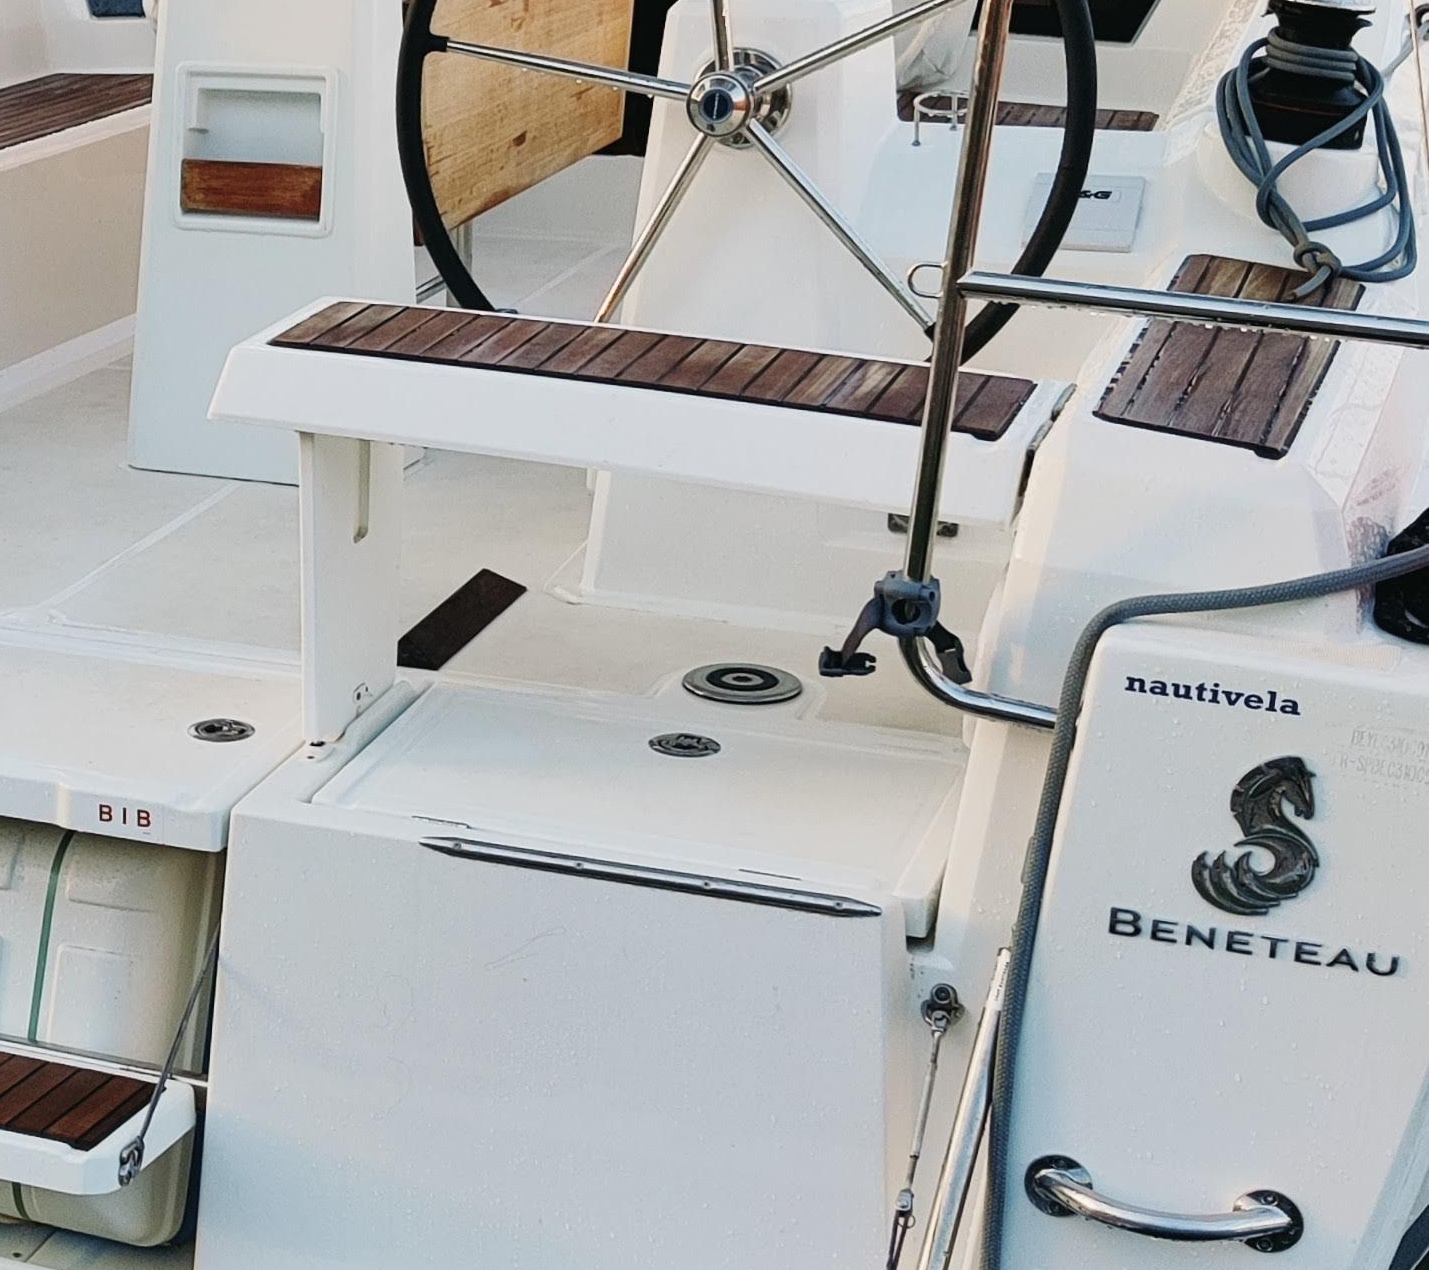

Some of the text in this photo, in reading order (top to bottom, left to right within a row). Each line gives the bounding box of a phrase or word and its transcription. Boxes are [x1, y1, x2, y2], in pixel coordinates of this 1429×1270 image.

[1079, 190, 1113, 200] &G
[1124, 676, 1301, 716] nautivela
[98, 804, 151, 827] BIB
[1108, 906, 1400, 976] BENETEAU
